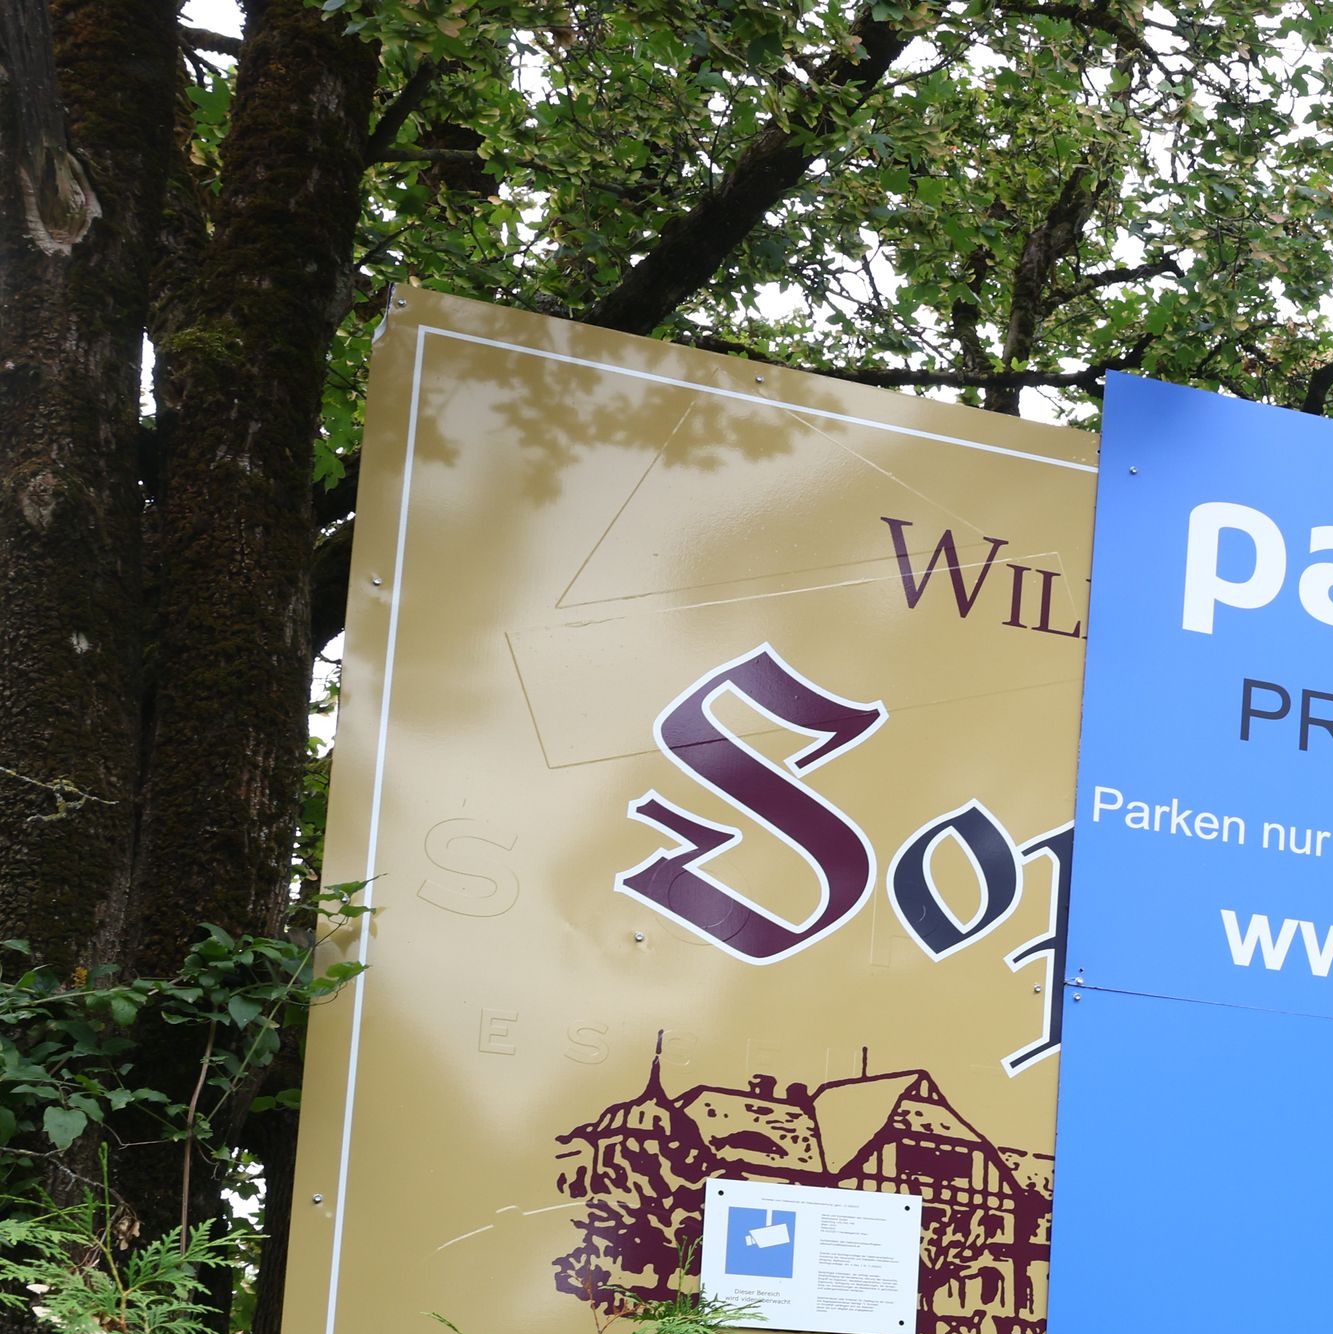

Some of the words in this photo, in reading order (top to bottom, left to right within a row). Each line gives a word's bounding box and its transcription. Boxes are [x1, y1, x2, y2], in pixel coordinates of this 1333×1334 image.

[881, 516, 1090, 639] WIL
[1092, 786, 1246, 845] Parken
[1262, 822, 1332, 857] nur
